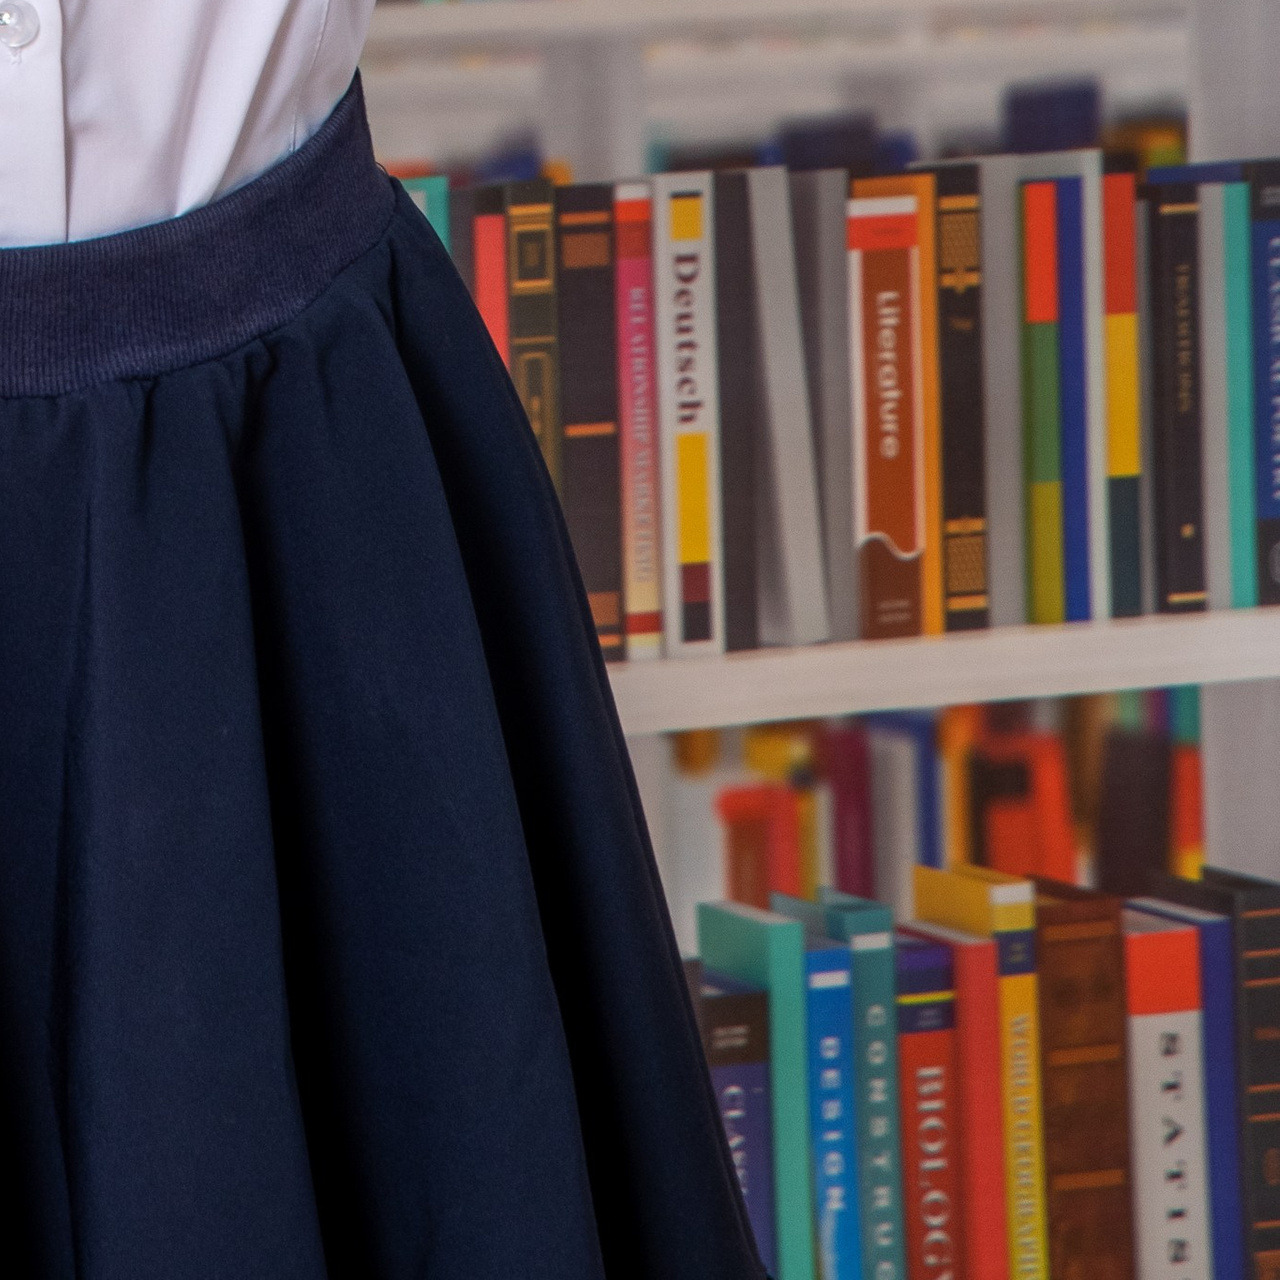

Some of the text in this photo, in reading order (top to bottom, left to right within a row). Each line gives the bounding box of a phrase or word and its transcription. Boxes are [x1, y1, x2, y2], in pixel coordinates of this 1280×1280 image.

[673, 251, 706, 425] Deutsch
[875, 290, 904, 460] Literature
[819, 1036, 846, 1211] DESIGN
[1013, 1120, 1043, 1280] GEOGRAPH
